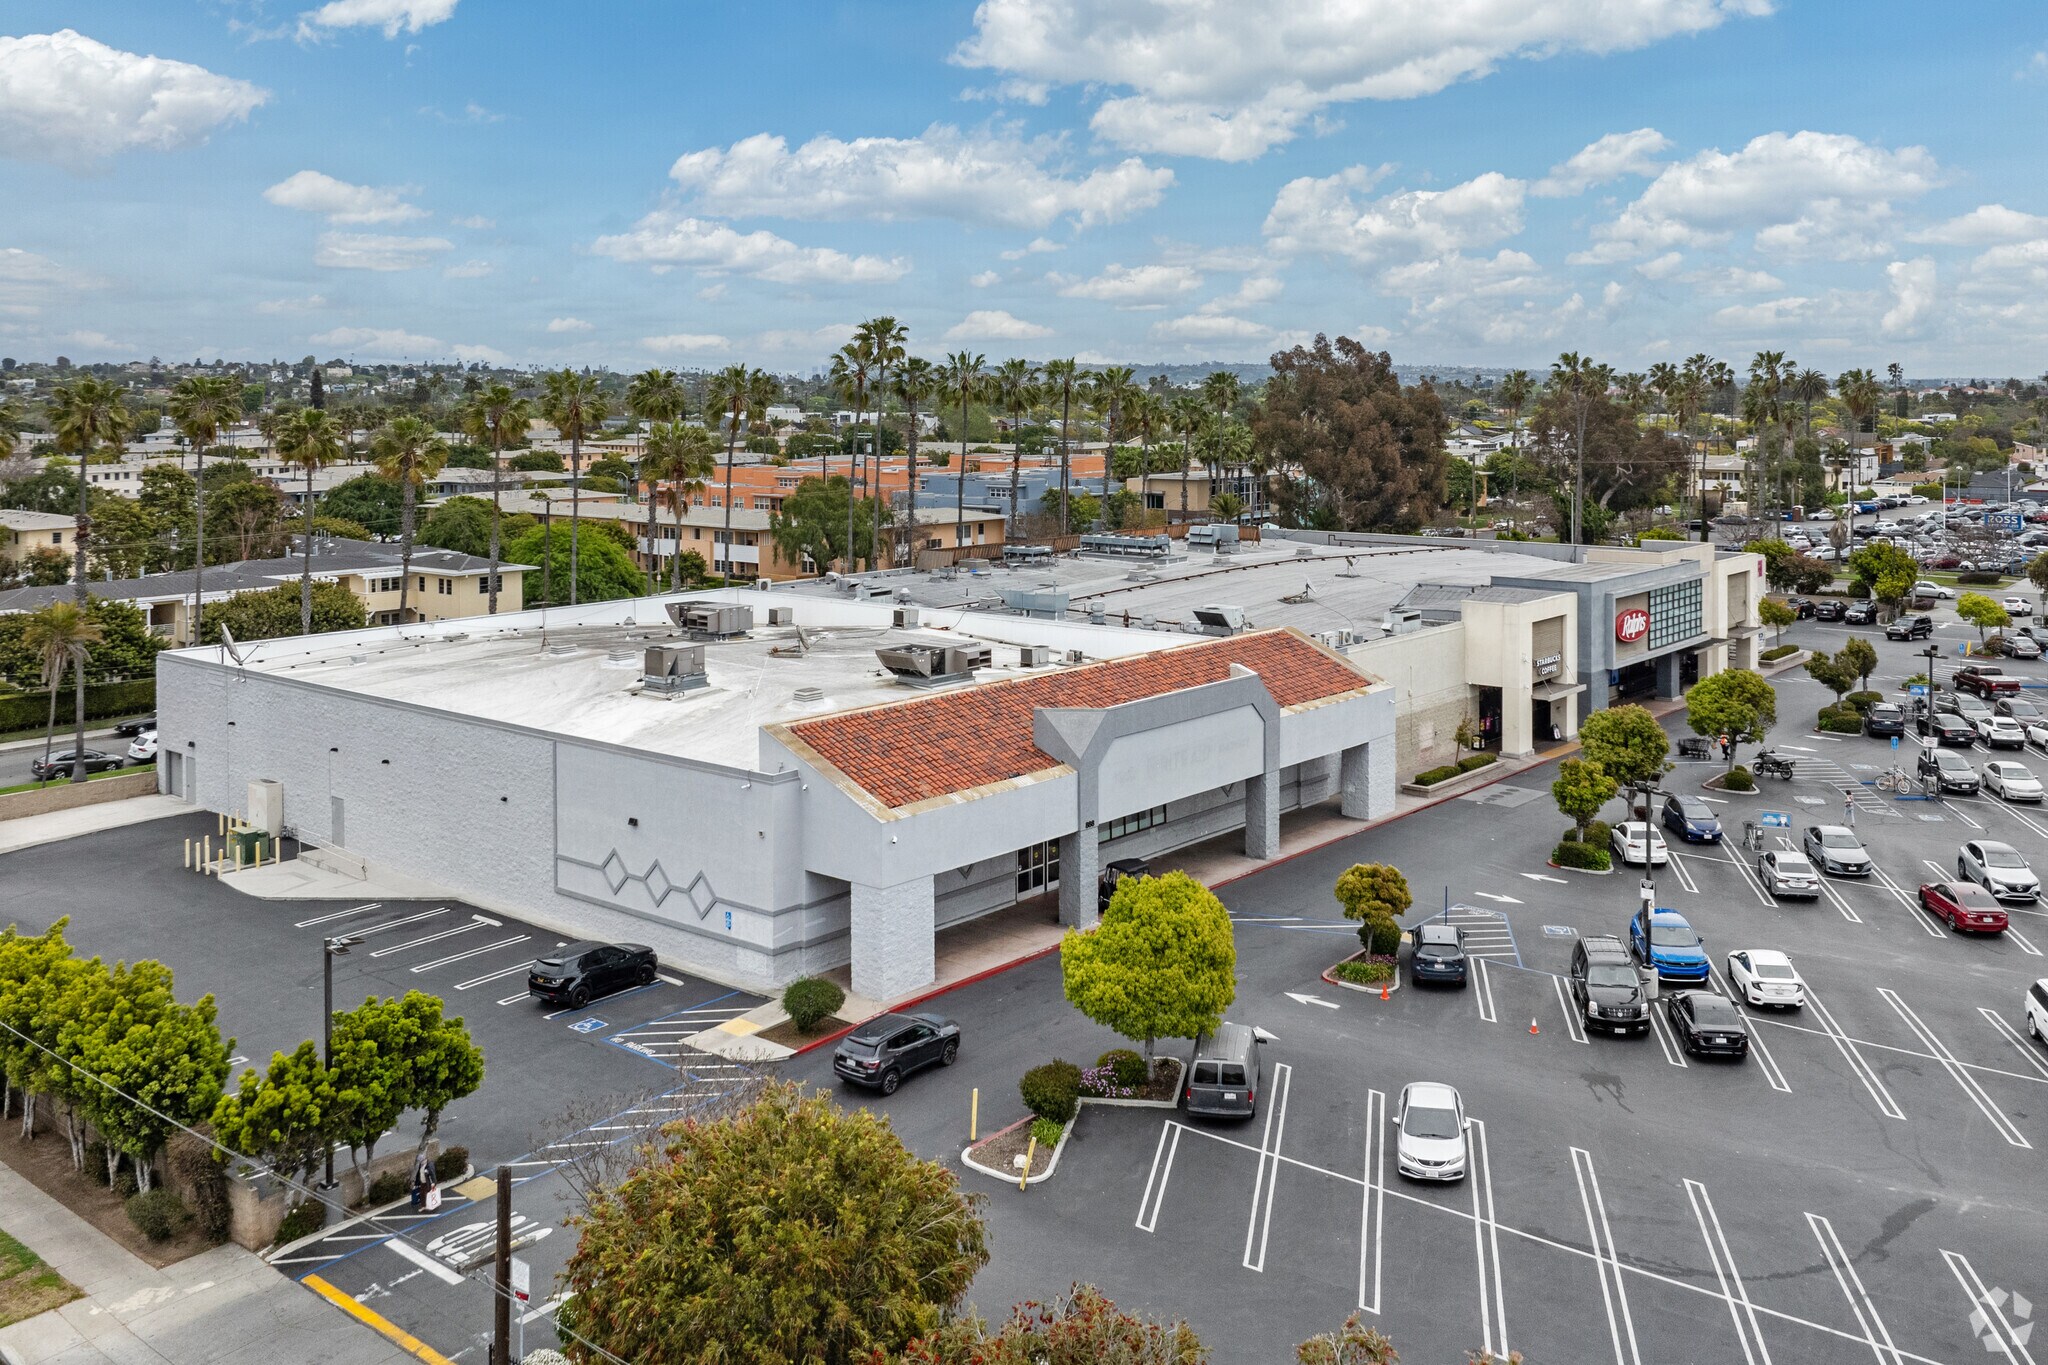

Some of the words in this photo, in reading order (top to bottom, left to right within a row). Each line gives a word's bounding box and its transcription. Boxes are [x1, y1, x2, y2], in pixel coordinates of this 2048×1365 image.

[1988, 515, 2018, 524] ROSS
[1622, 612, 1646, 638] Ralphs
[1537, 654, 1561, 667] STARBUCKS
[1541, 664, 1557, 675] COFFEE
